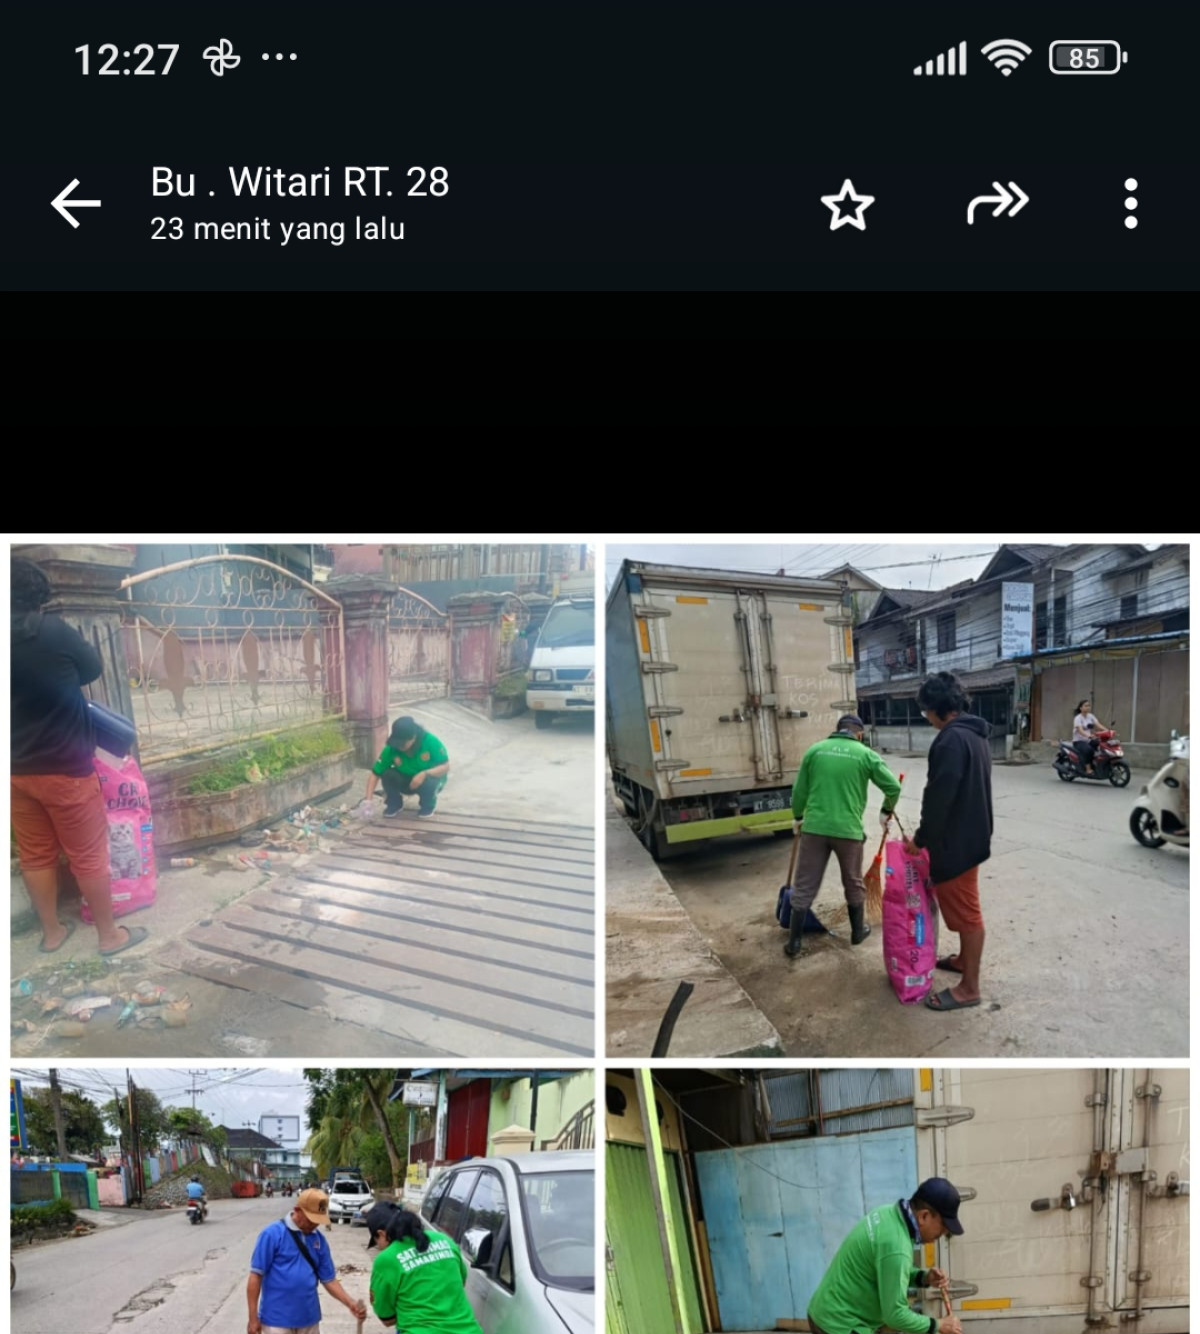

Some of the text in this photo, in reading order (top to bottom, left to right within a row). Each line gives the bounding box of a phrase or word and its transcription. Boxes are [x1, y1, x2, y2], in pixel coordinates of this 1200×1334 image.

[75, 43, 180, 76] 12:27
[1069, 47, 1100, 69] 85
[152, 166, 195, 198] Bu
[228, 165, 331, 198] Witari
[344, 165, 393, 198] RT.
[406, 166, 450, 198] 28
[151, 215, 405, 247] 23 menit yang lalu
